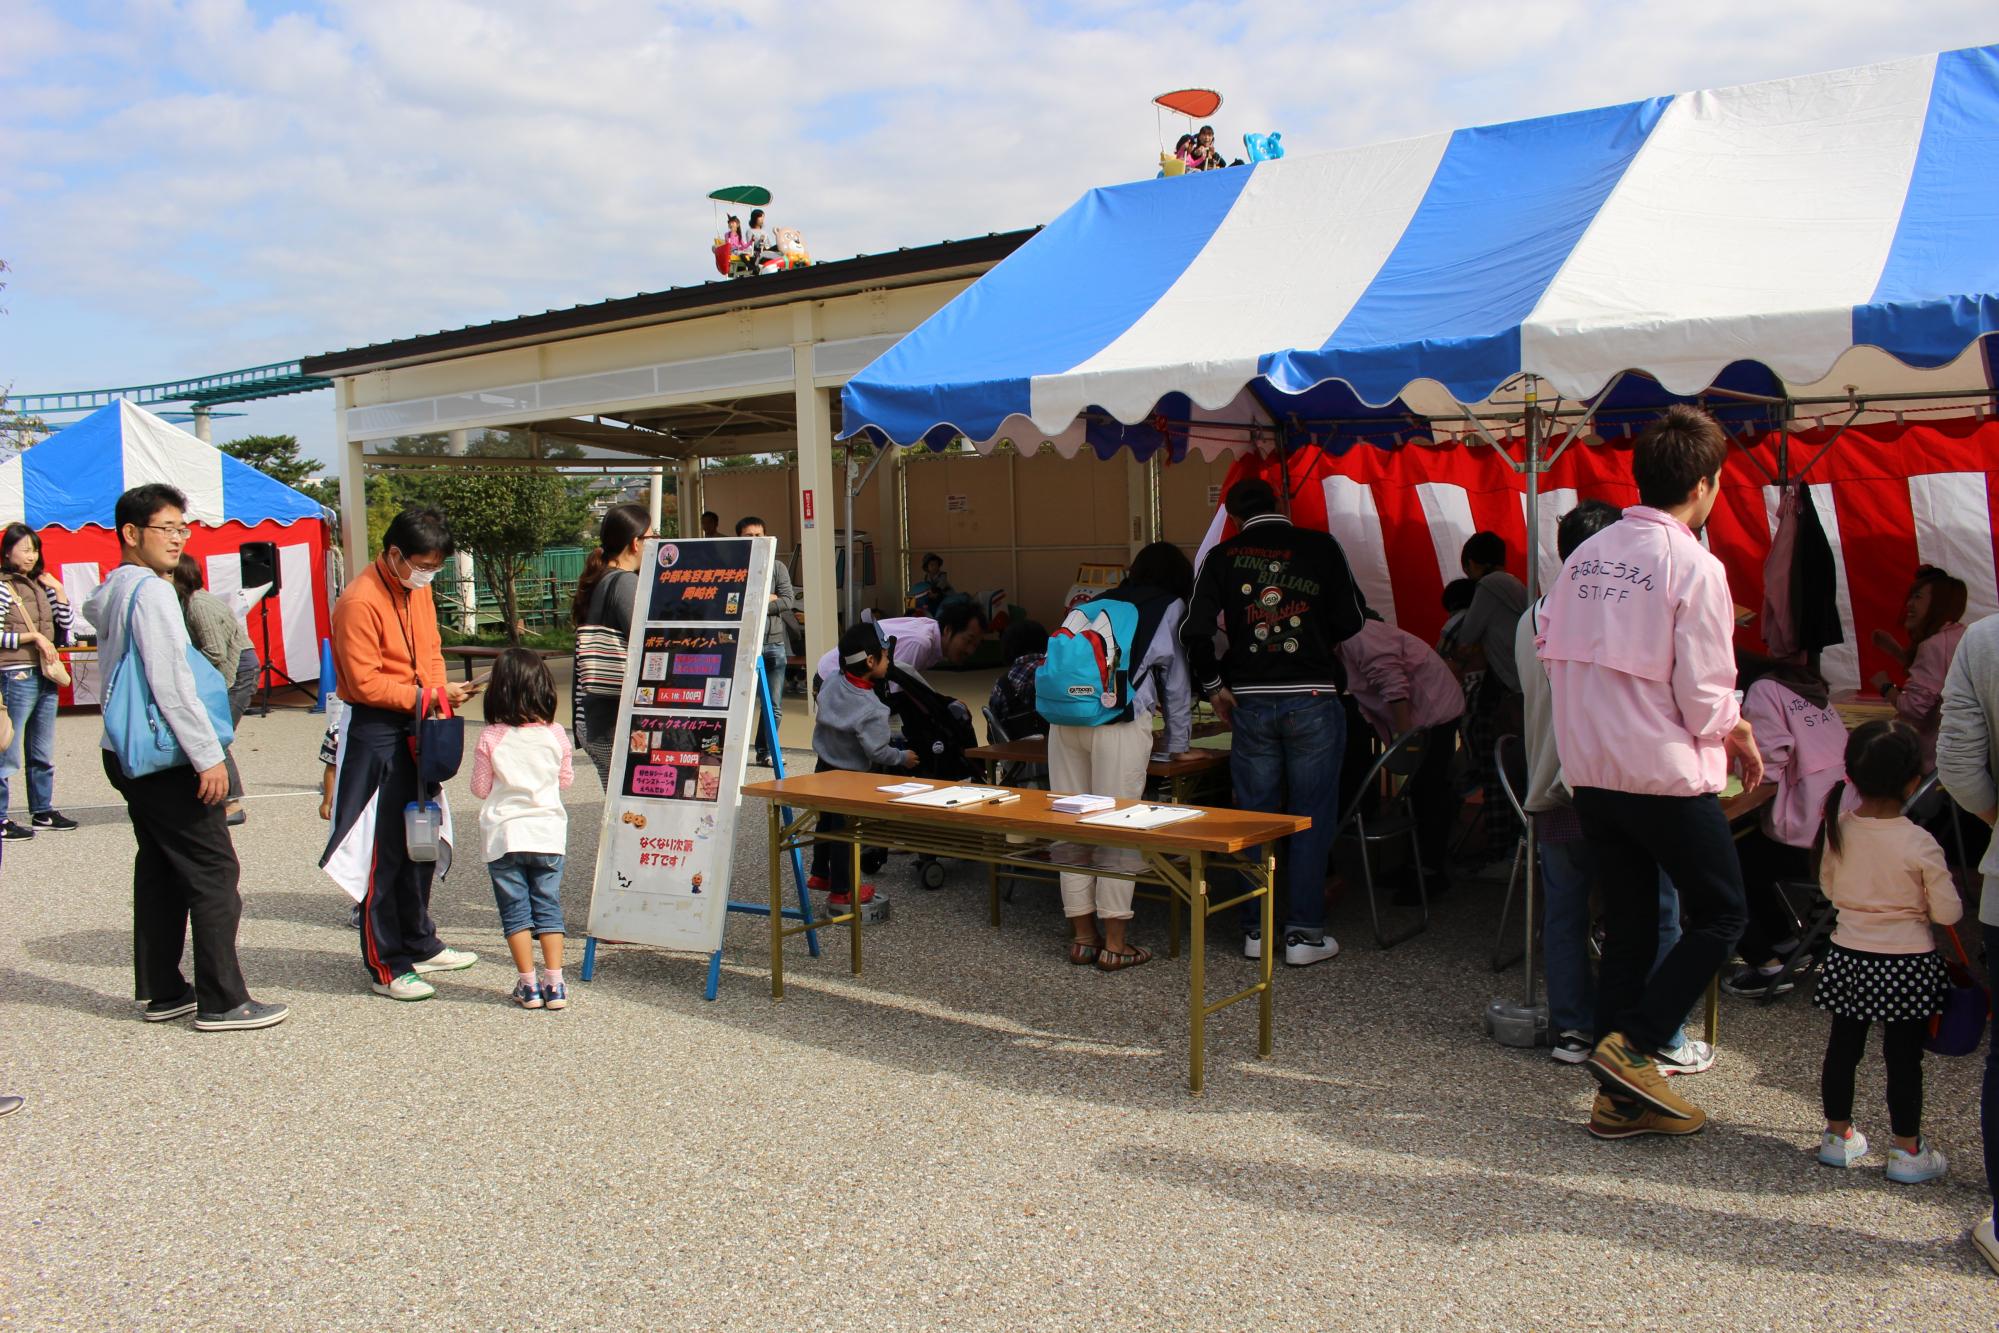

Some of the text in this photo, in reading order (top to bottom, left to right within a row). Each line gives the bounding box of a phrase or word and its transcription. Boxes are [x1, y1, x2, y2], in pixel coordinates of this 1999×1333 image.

[1233, 555, 1269, 570] KING
[659, 569, 747, 583] 中部美容専門学校
[1570, 559, 1655, 592] みなみこうえん
[682, 586, 718, 600] 岡崎校
[1577, 584, 1630, 603] STFF
[645, 637, 717, 648] ボディーペイント
[682, 691, 702, 701] 100円
[641, 718, 722, 731] クイックネイルアート
[680, 753, 699, 764] 100円
[639, 837, 694, 853] なくなり次第
